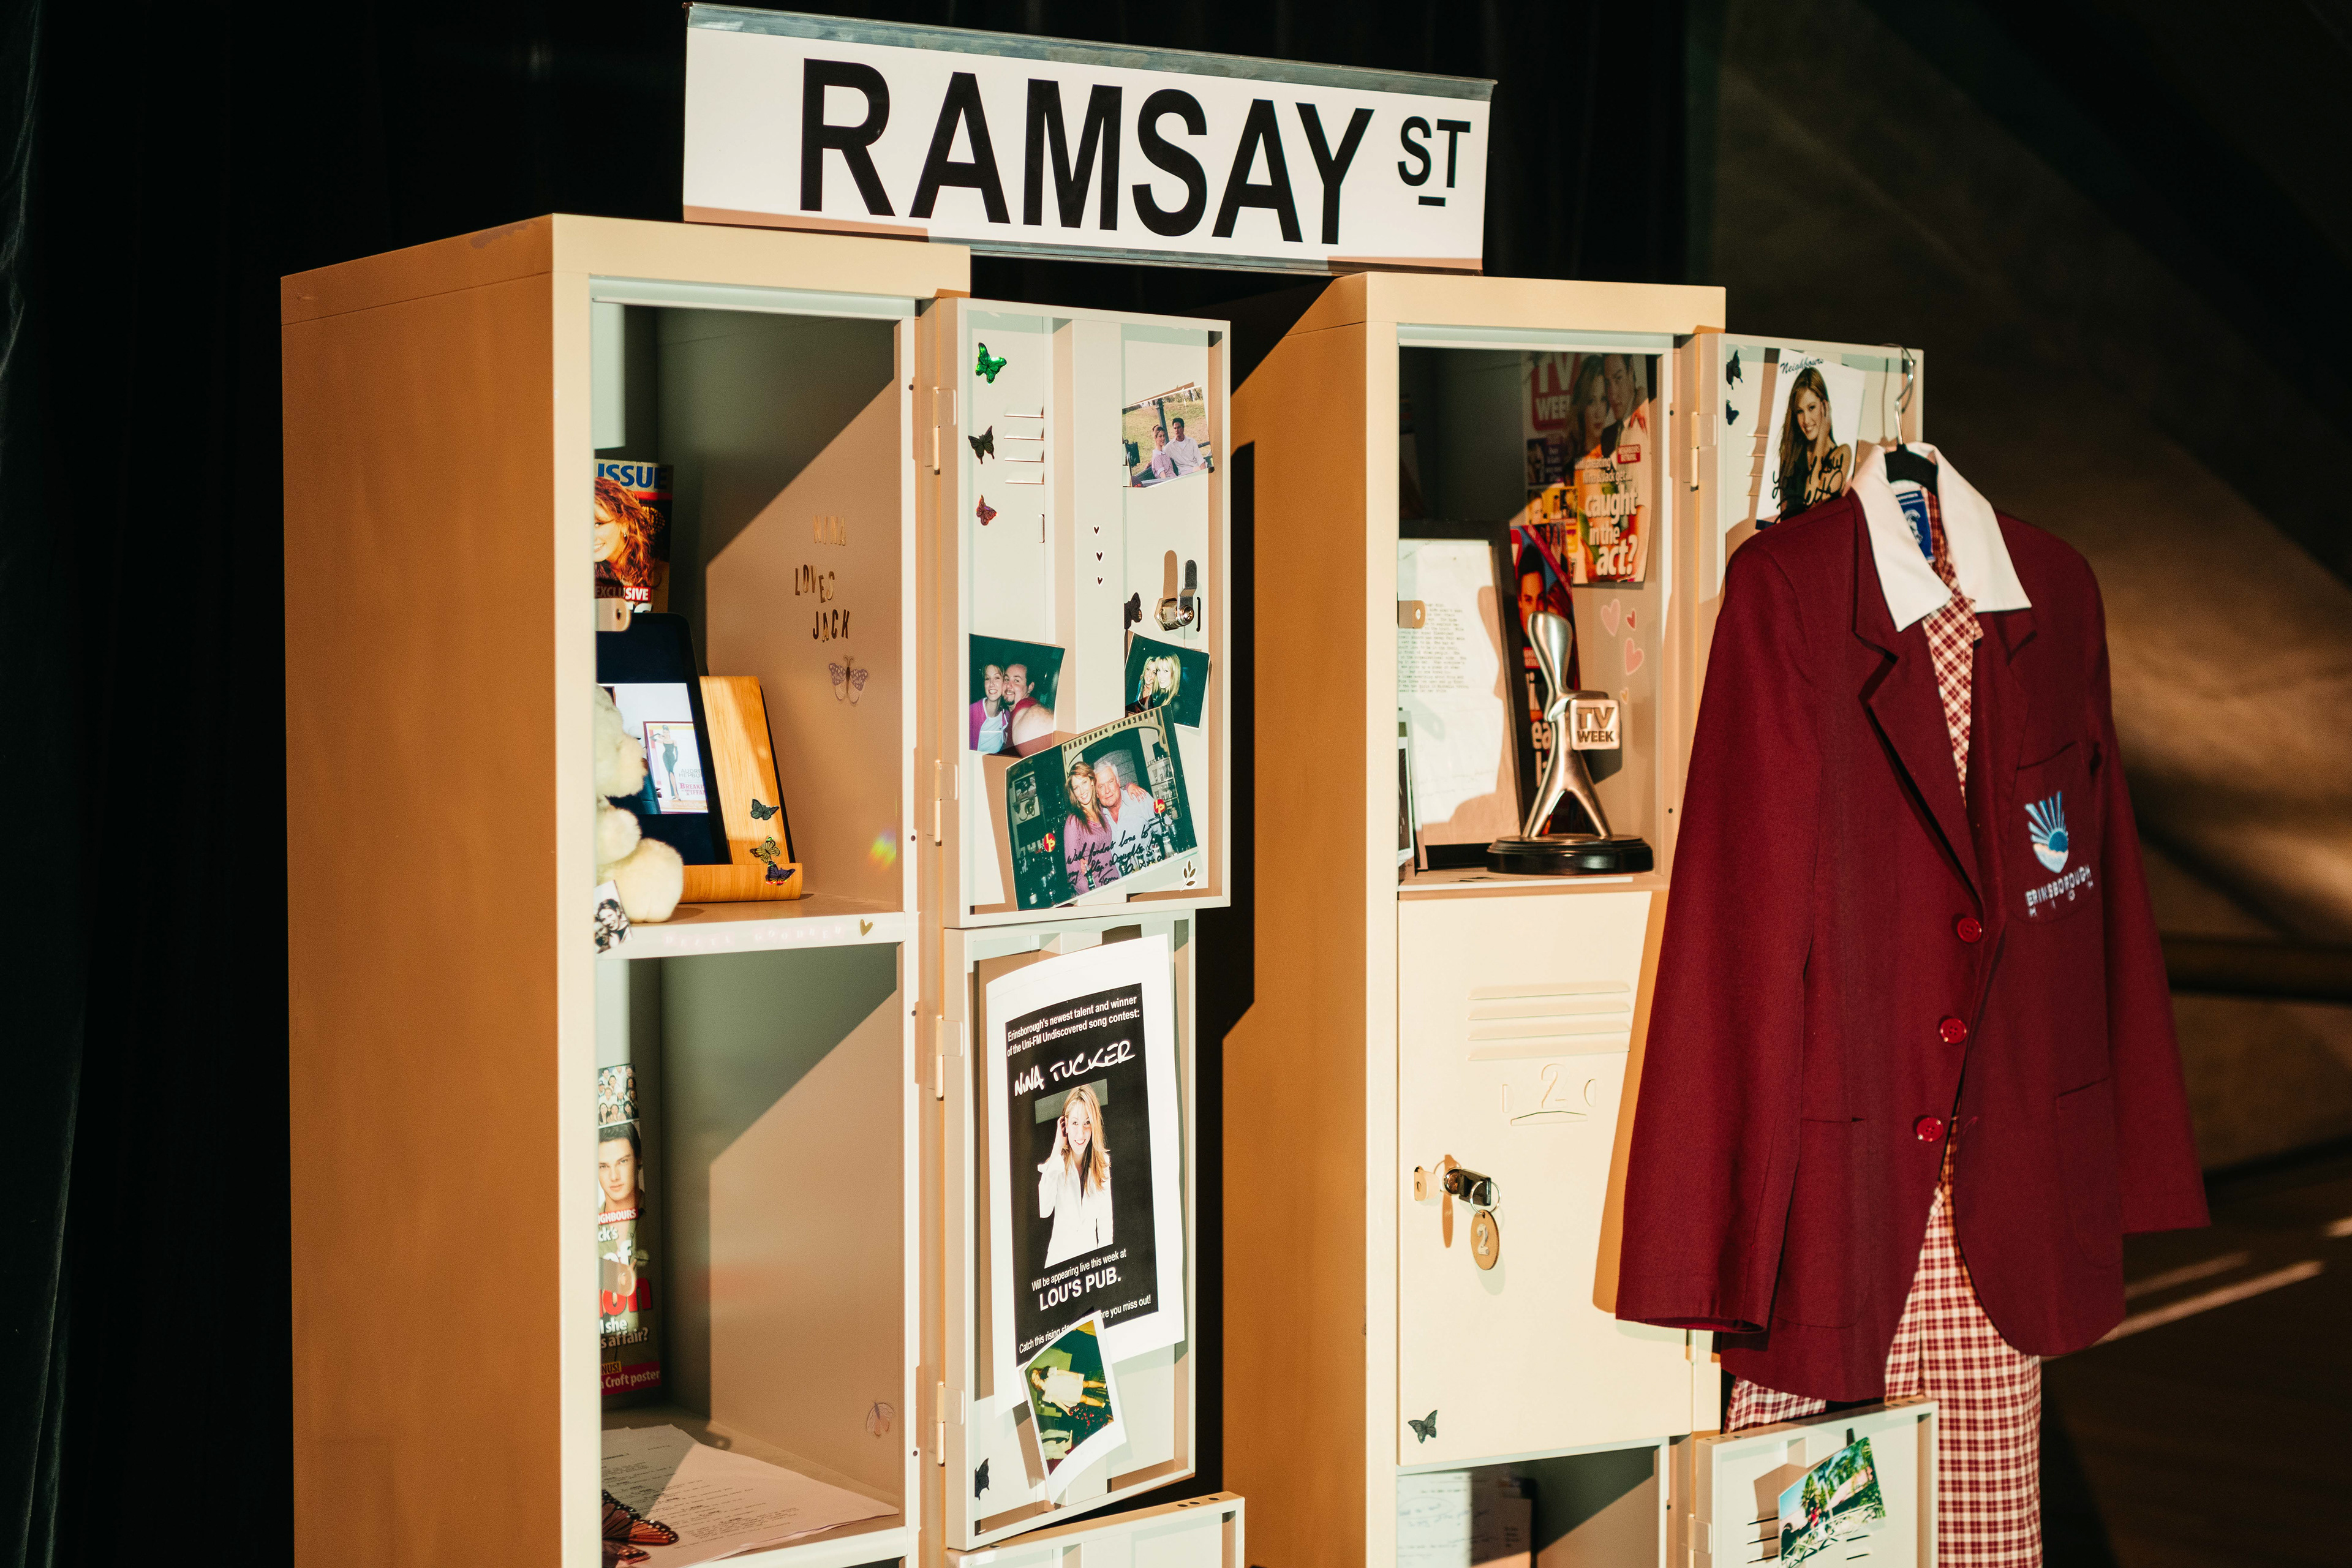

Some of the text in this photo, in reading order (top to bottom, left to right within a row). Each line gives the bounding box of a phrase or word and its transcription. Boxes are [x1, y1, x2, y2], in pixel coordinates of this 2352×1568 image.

[800, 58, 1471, 245] RAMSAY ST
[1779, 356, 1824, 374] Neighbours
[1534, 394, 1573, 421] WEE
[597, 463, 668, 490] ISSUE
[1585, 483, 1638, 525] caught
[813, 514, 846, 546] NINA
[1589, 522, 1620, 545] in the
[1596, 534, 1638, 576] act?
[595, 586, 649, 601] EXCLUSIVE
[795, 564, 835, 603] LOVES
[813, 609, 850, 642] JACK
[1576, 707, 1615, 729] TV
[1577, 731, 1615, 743] WEEK
[2025, 864, 2092, 907] ERINSBOROUGH
[1007, 1009, 1140, 1057] of the Uni-FM Undiscovered song contest:
[1008, 996, 1137, 1042] Erinsborough's newest talent and winner
[1049, 1040, 1136, 1082] TUCKER
[1540, 1063, 1569, 1109] 2
[1477, 1223, 1490, 1256] 2
[1031, 1248, 1127, 1291] Will be appearing live this week at
[1039, 1266, 1121, 1311] LOU'S PUB.
[605, 1317, 628, 1333] she
[608, 1327, 649, 1348] affair?
[1019, 1338, 1035, 1354] Catch
[1035, 1335, 1044, 1346] this
[1045, 1330, 1061, 1343] rising
[1110, 1306, 1121, 1318] you
[1123, 1300, 1137, 1311] miss
[1139, 1294, 1152, 1307] out!
[605, 1373, 630, 1389] Croft
[630, 1370, 660, 1387] poster
